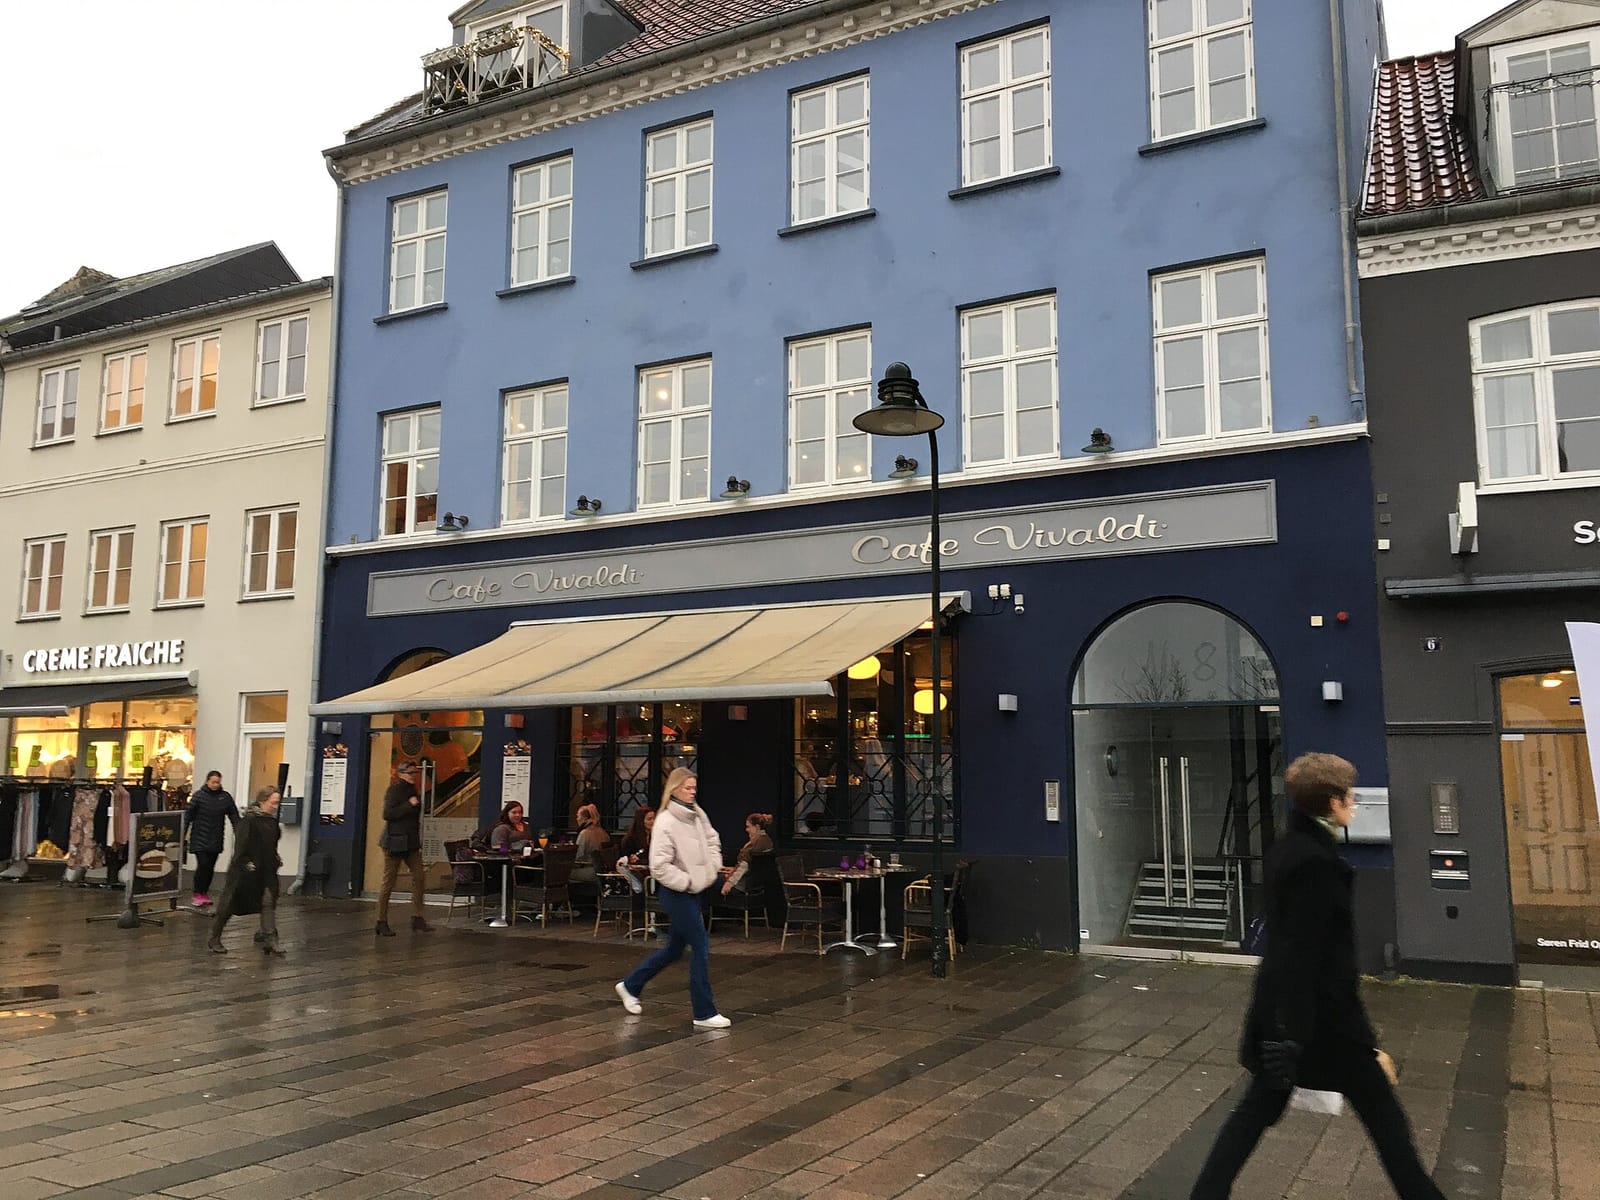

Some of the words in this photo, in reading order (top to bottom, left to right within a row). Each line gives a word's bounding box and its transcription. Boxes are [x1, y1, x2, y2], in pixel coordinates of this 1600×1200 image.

[852, 531, 960, 565] Cafe
[973, 514, 1163, 550] Vivaldi
[1573, 520, 1600, 544] S
[427, 576, 502, 603] Cafe
[512, 563, 640, 593] Vivaldi
[23, 646, 91, 673] CREME
[94, 639, 184, 669] FRAICHE
[1193, 641, 1217, 682] 8
[1427, 639, 1436, 650] 6
[1568, 939, 1590, 949] Frid
[1590, 940, 1600, 951] O
